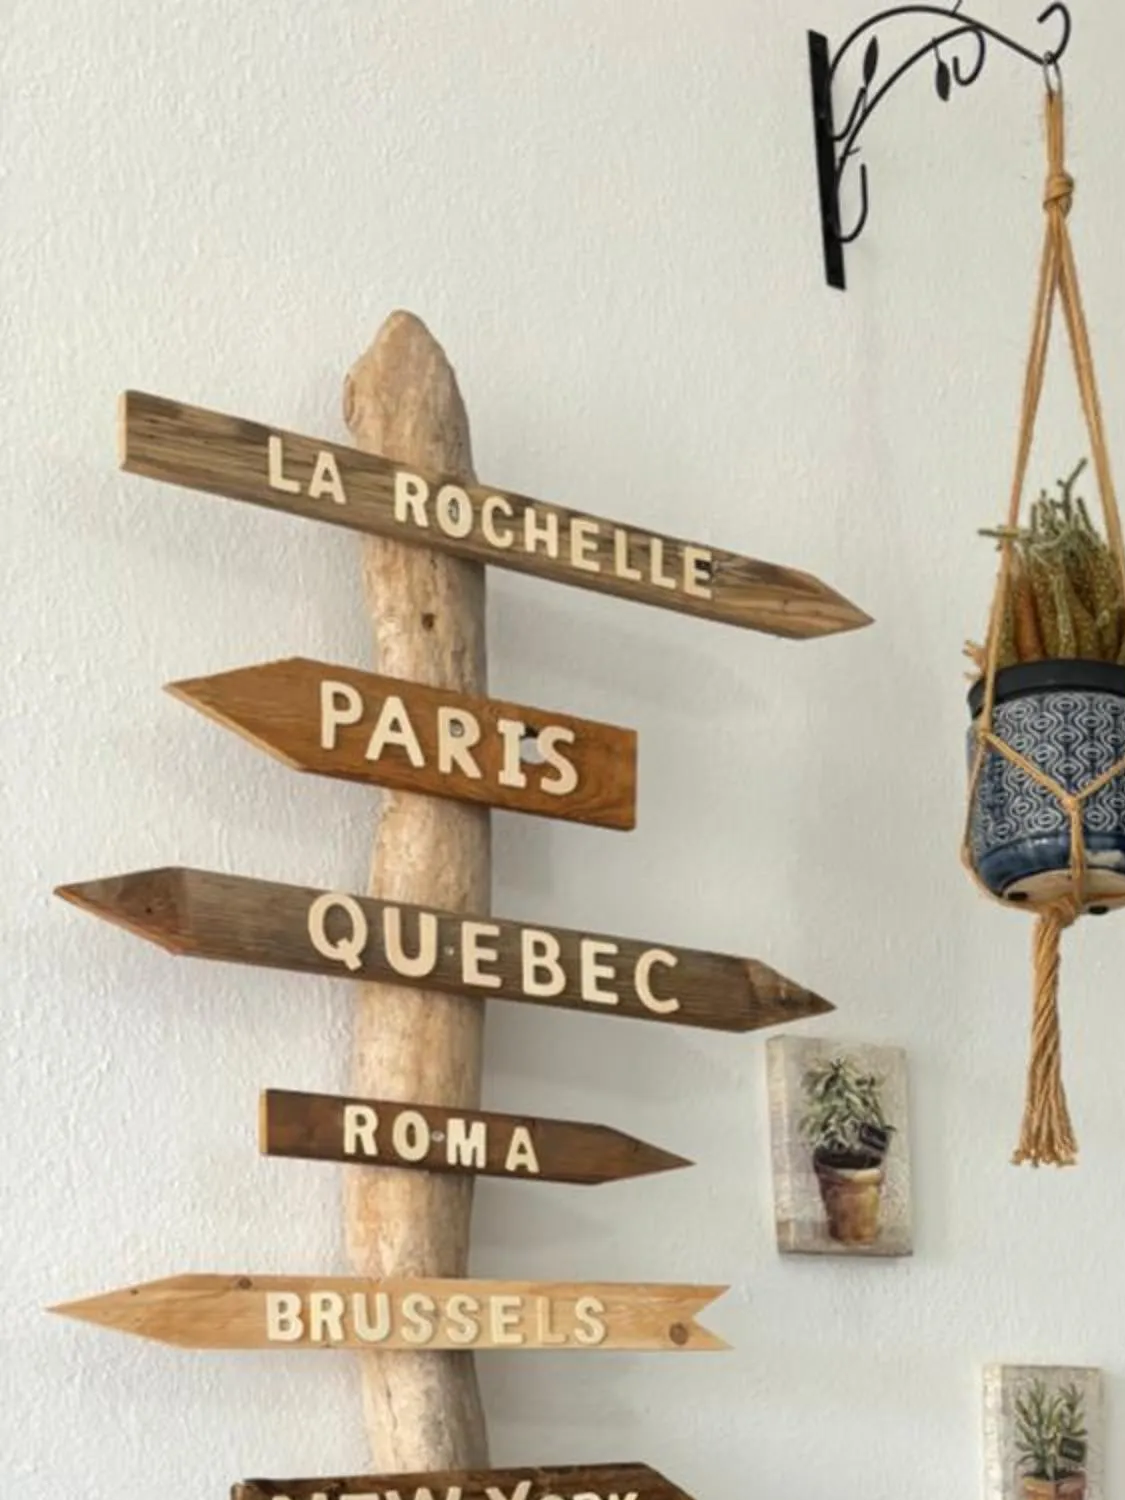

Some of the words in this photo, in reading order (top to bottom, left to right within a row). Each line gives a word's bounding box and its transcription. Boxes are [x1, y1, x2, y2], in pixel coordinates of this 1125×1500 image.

[266, 435, 346, 505] LA
[395, 471, 714, 600] ROCHELLE
[319, 680, 579, 796] PARIS
[307, 891, 681, 1014] QUEBEC
[342, 1104, 541, 1174] ROMA
[265, 1290, 608, 1347] BRUSSELS
